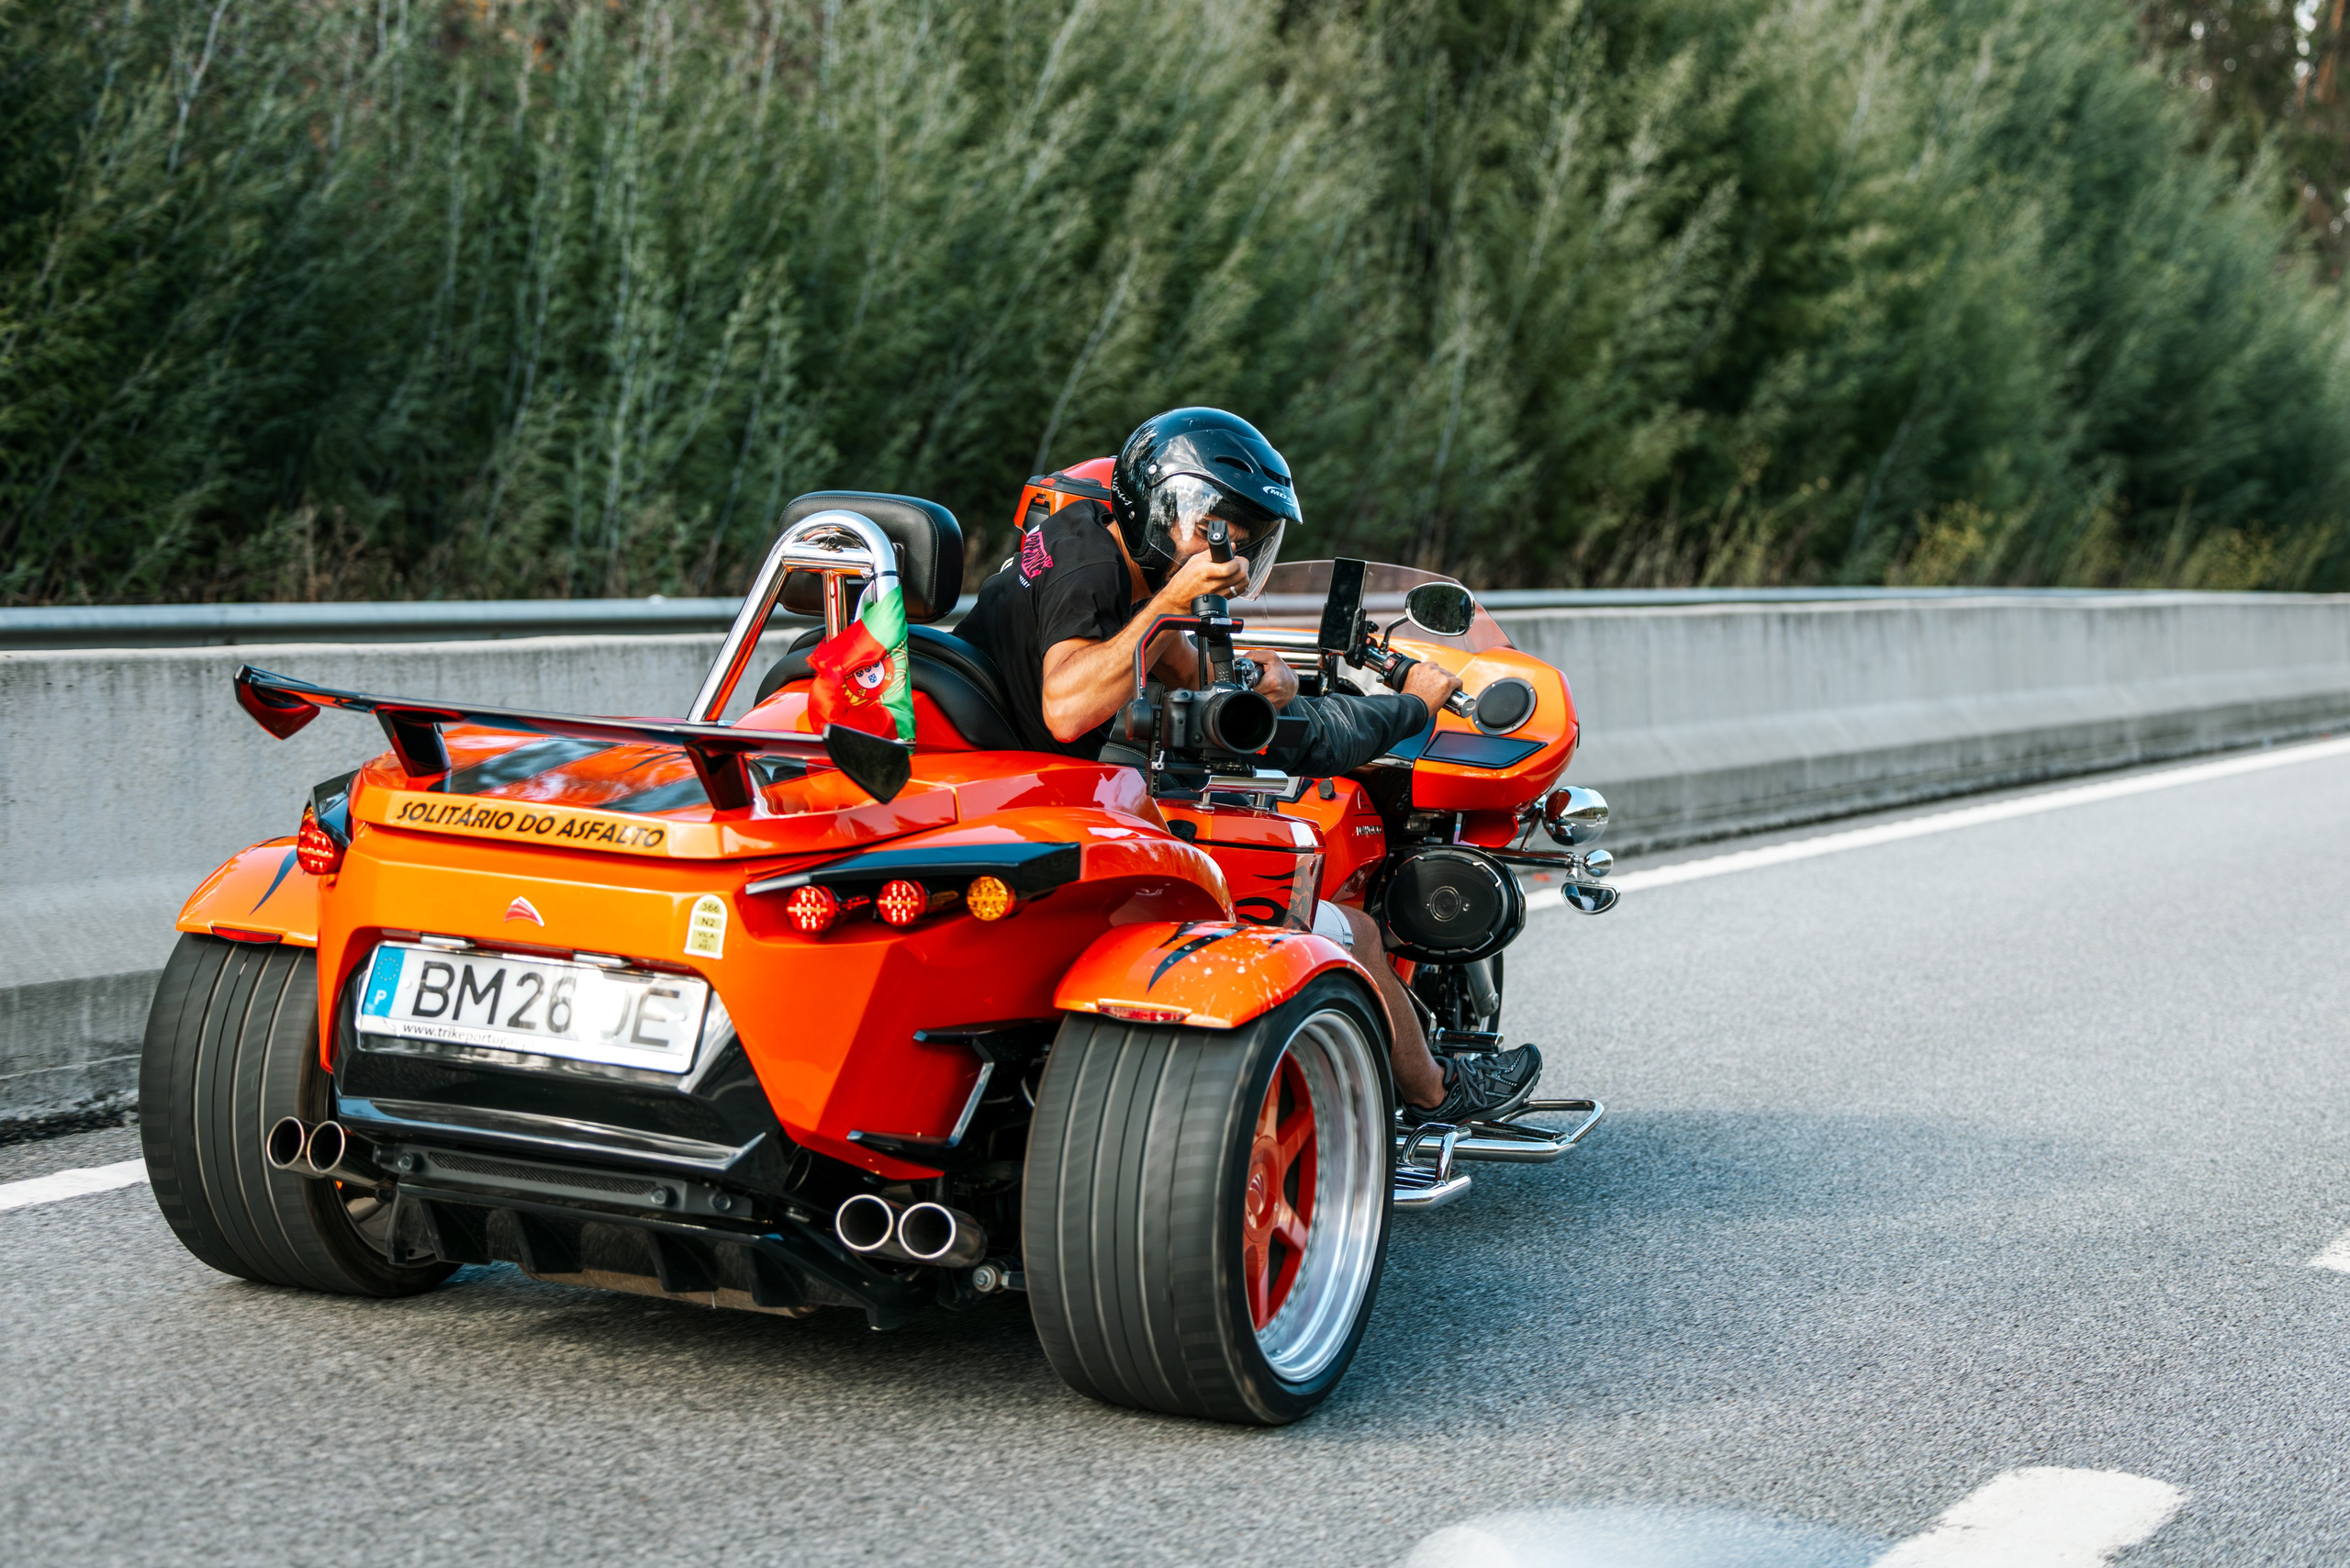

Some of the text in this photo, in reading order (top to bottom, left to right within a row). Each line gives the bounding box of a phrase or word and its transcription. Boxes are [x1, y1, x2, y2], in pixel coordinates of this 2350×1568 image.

[397, 801, 665, 847] SOLITÁRIO DO ASFALTO
[374, 990, 387, 1005] P
